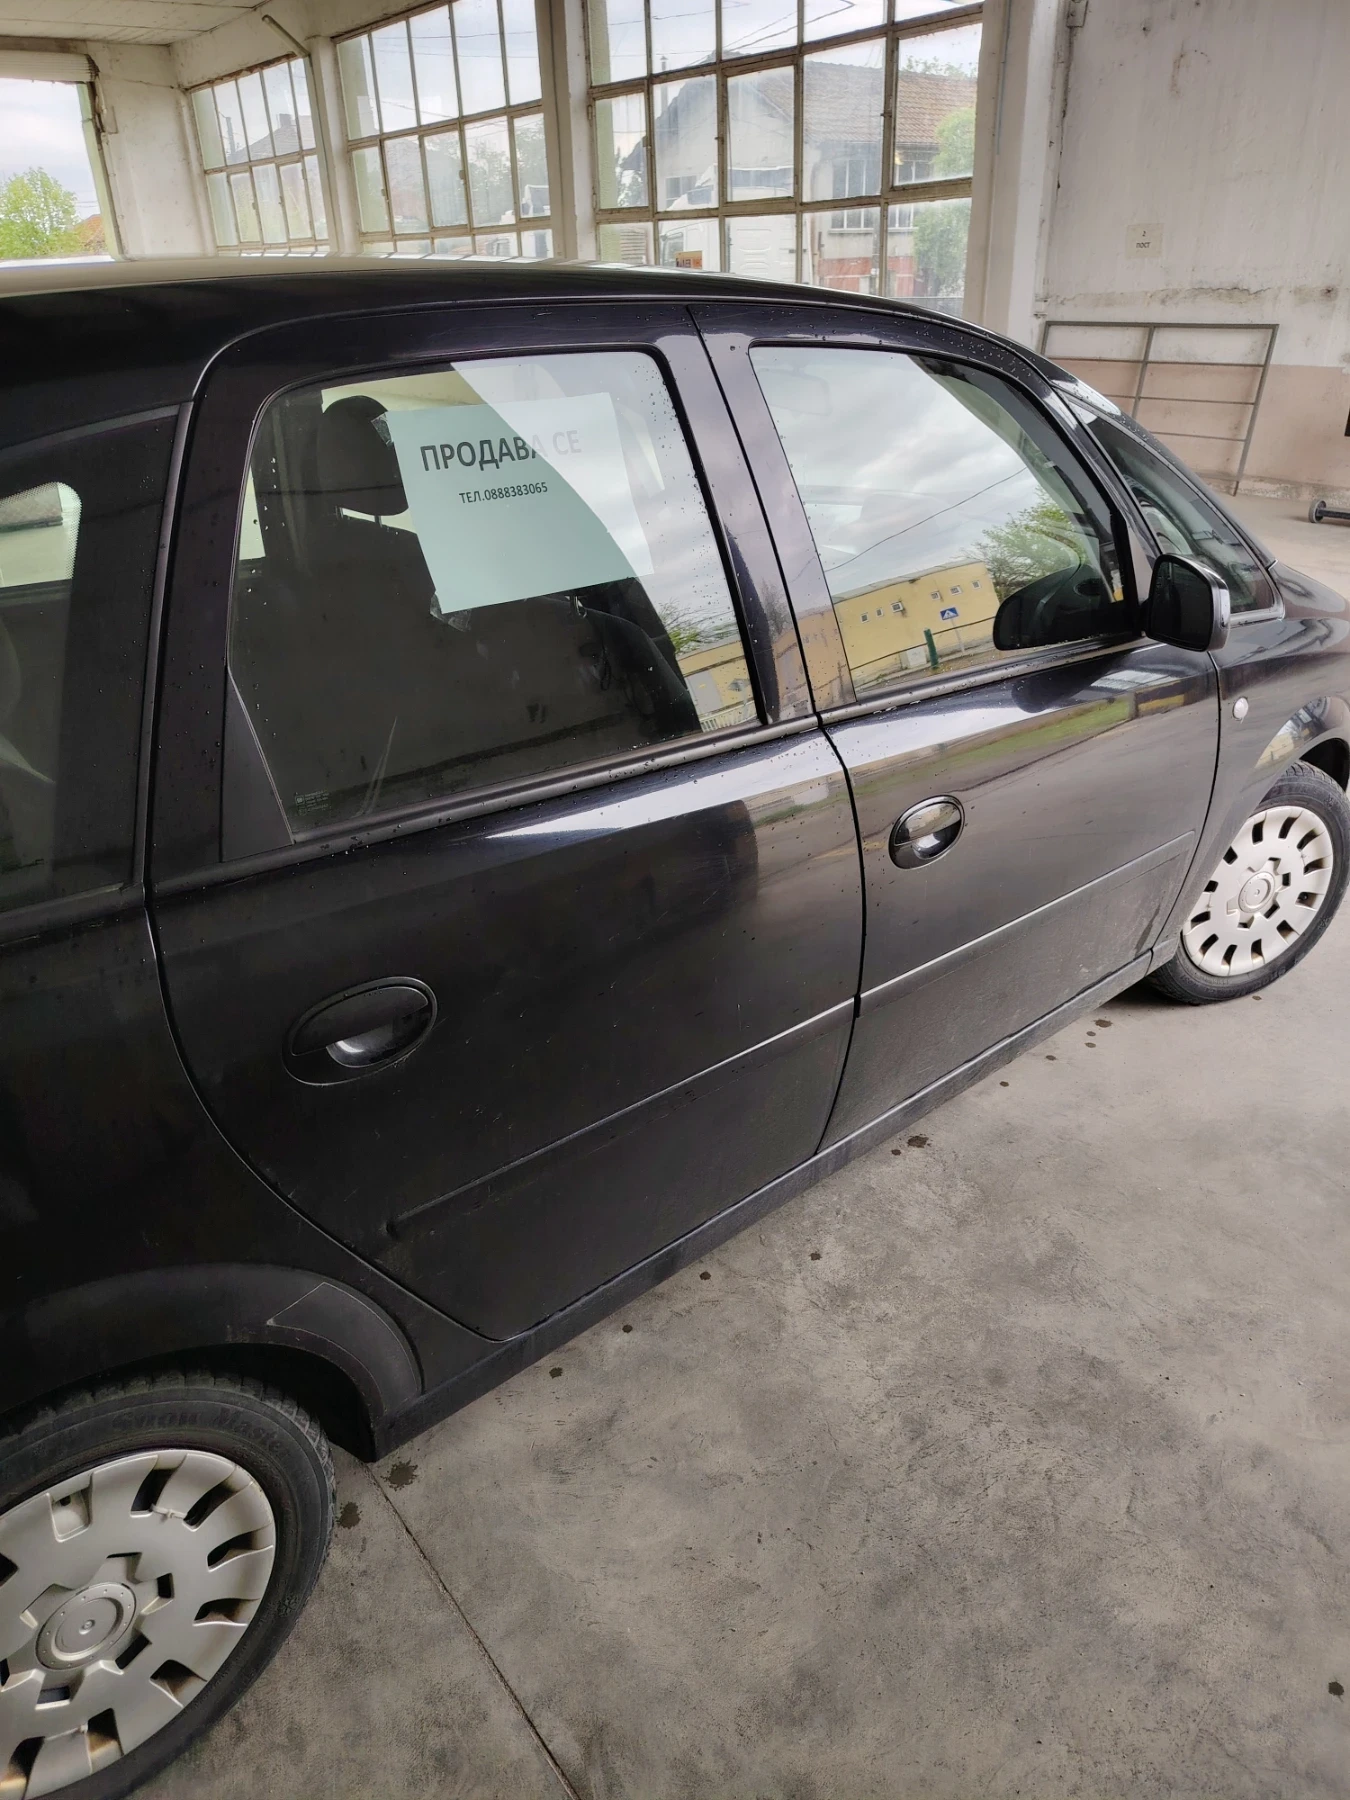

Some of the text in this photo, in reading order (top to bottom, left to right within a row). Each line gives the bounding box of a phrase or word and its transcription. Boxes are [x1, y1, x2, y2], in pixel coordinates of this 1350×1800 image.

[420, 429, 582, 472] ПРОДАВА СЕ
[458, 481, 548, 504] ТЕЛ.0888383065
